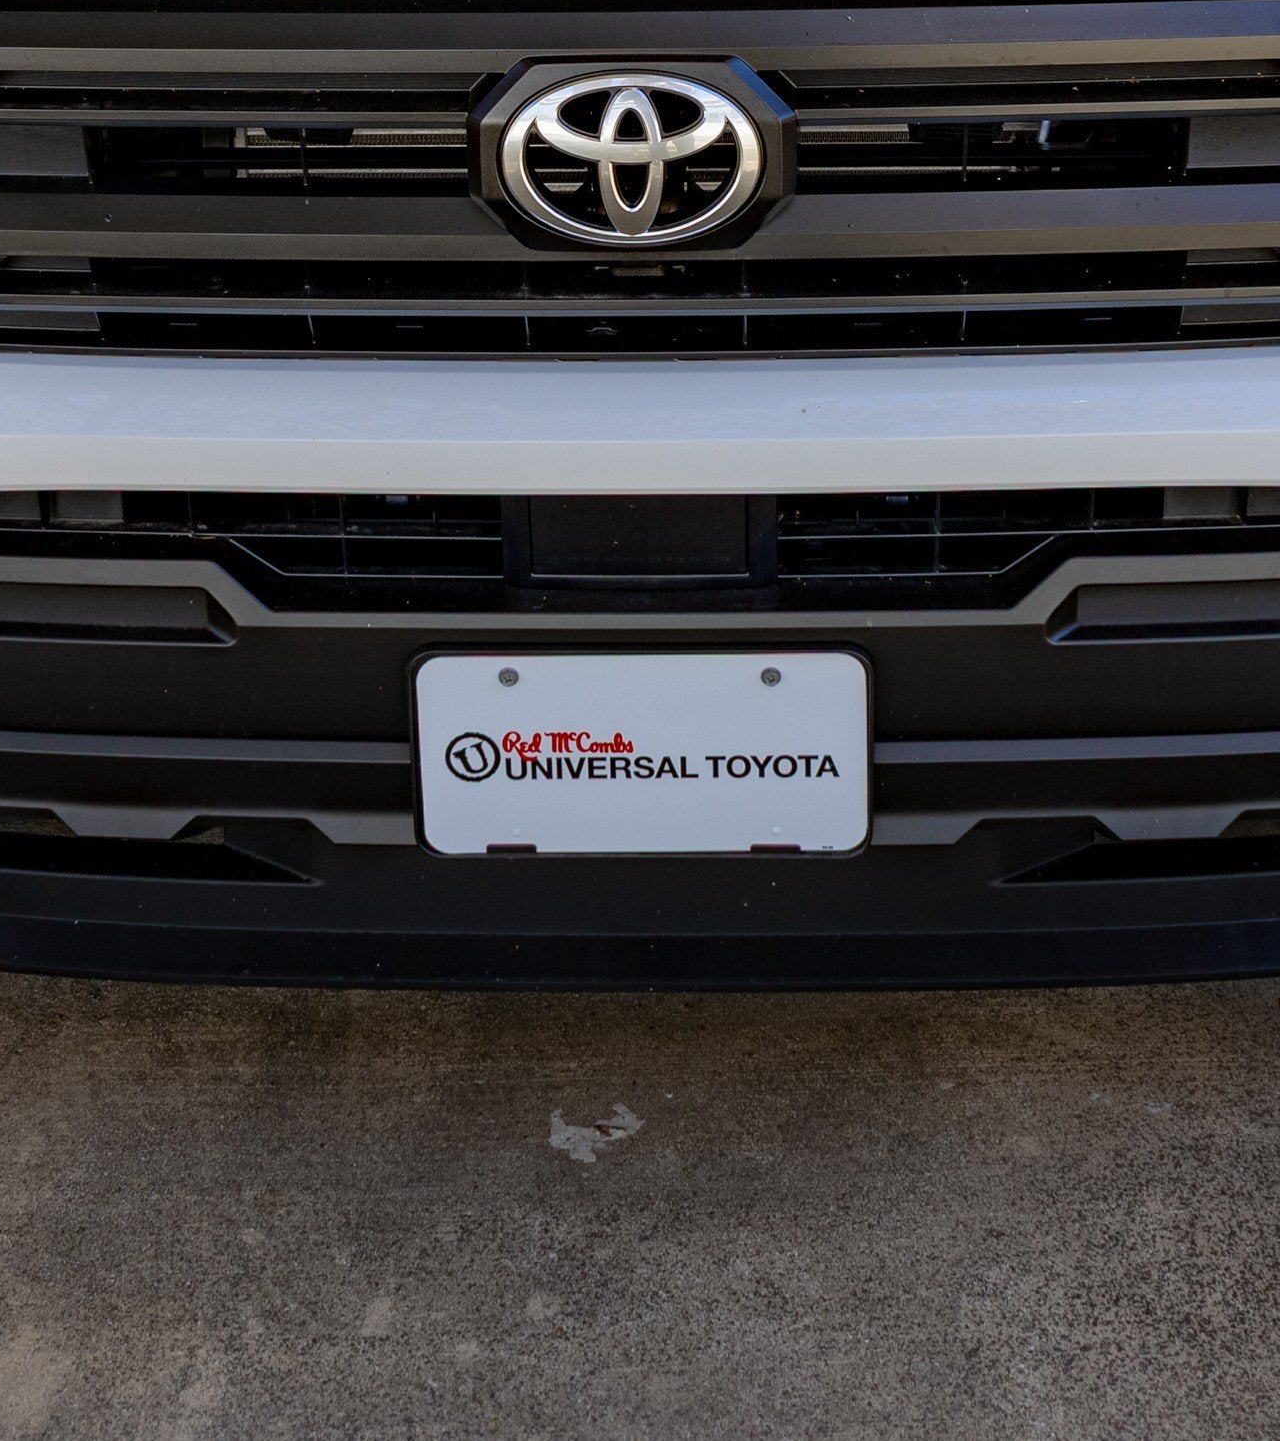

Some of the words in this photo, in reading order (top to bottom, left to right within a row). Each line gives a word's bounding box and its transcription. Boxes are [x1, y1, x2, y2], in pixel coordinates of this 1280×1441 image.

[502, 731, 542, 761] Red
[544, 731, 634, 753] McCombs
[505, 756, 698, 780] UNIVERSAL
[705, 755, 839, 778] TOYOTA
